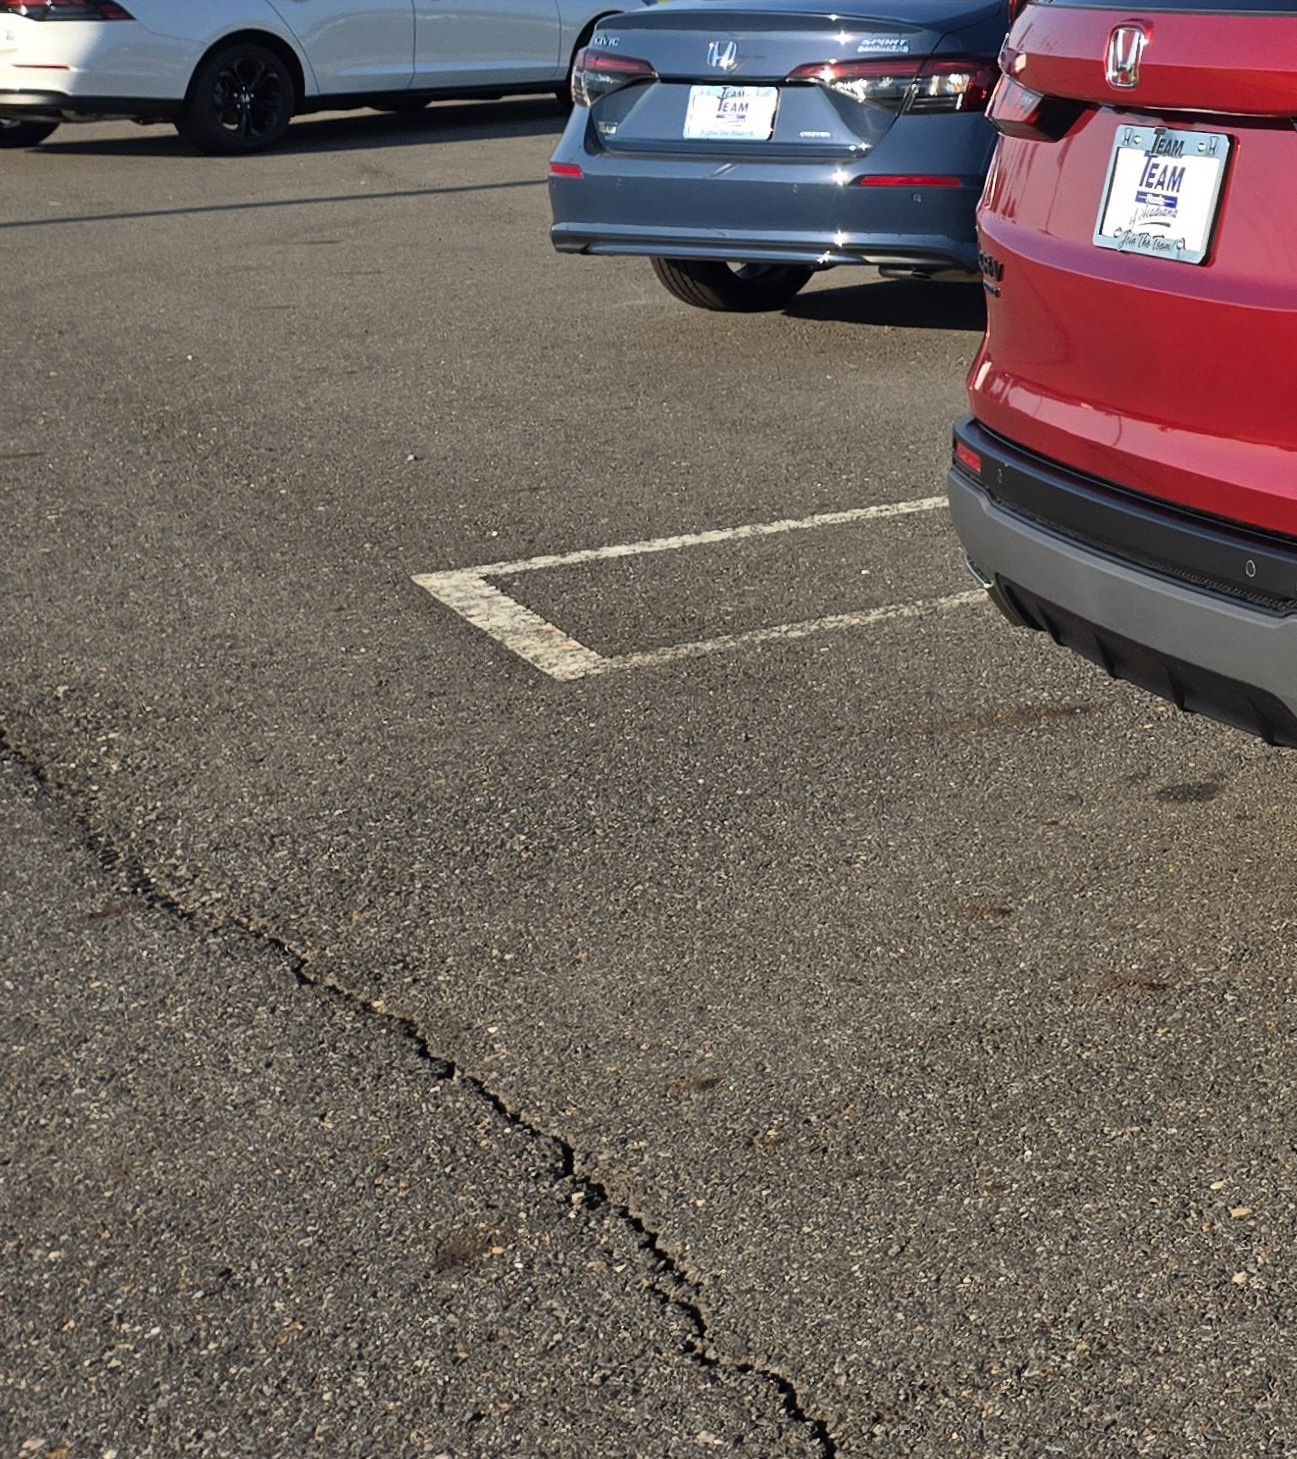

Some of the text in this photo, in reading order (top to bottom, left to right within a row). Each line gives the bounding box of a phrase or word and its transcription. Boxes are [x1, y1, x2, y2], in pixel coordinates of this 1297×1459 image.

[717, 96, 749, 112] TEAM
[1151, 127, 1185, 158] TEAM
[1139, 149, 1187, 193] TEAM
